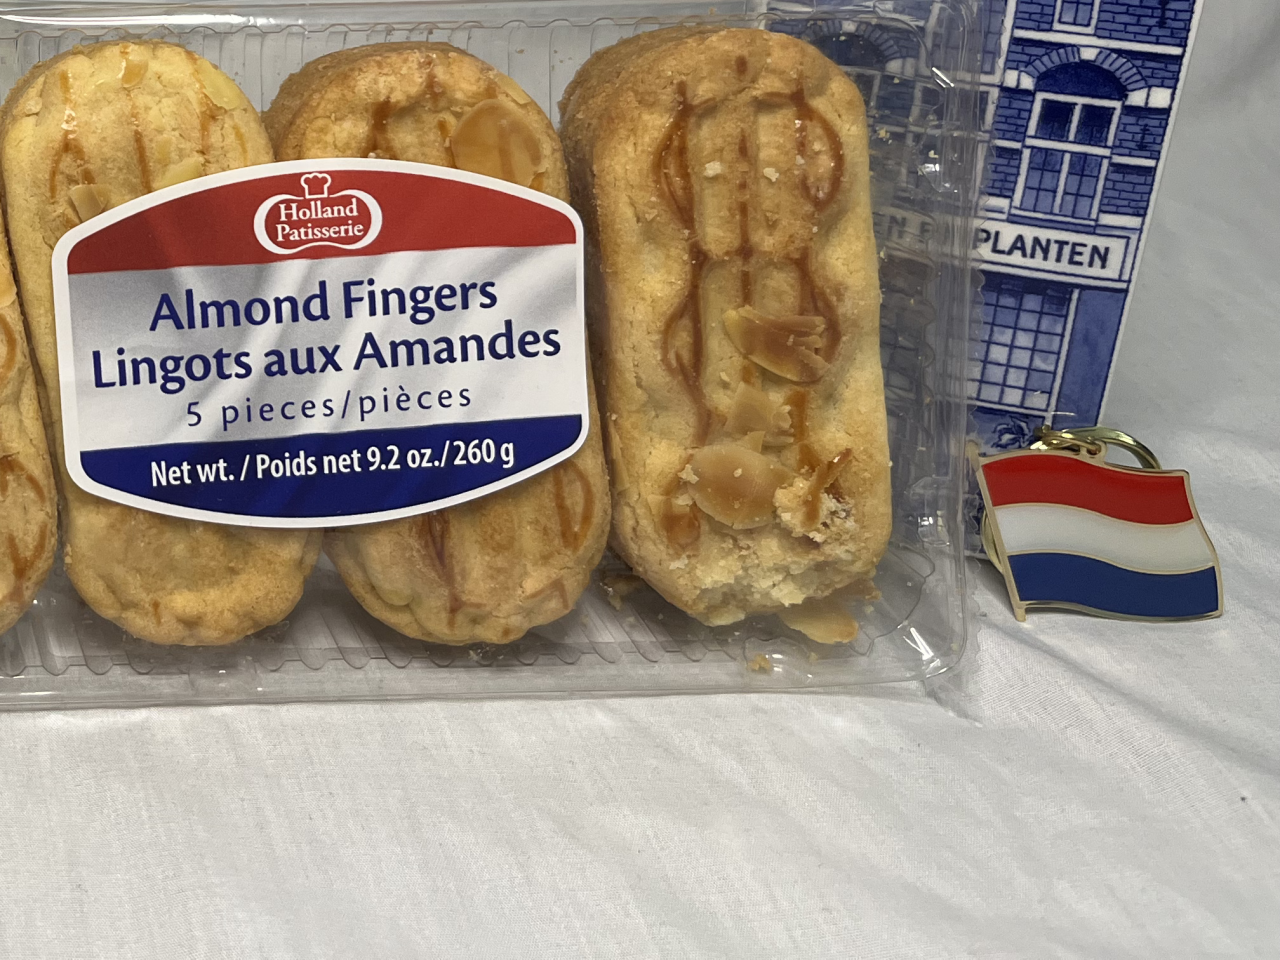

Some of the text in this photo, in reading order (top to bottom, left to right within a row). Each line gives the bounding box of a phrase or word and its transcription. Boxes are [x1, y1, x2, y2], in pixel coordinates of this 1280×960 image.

[278, 197, 359, 221] Holland
[275, 220, 365, 242] Patisserie
[971, 227, 1111, 270] PLANTEN
[149, 277, 498, 332] Almond Fingers
[92, 318, 561, 395] Lingots aux Amandes
[186, 400, 202, 427] 5
[150, 459, 192, 488] Net
[195, 458, 235, 483] wt.
[239, 453, 251, 482] /
[255, 449, 318, 480] Poids
[322, 448, 362, 475] net
[366, 444, 401, 471] 9.2
[500, 441, 514, 468] g
